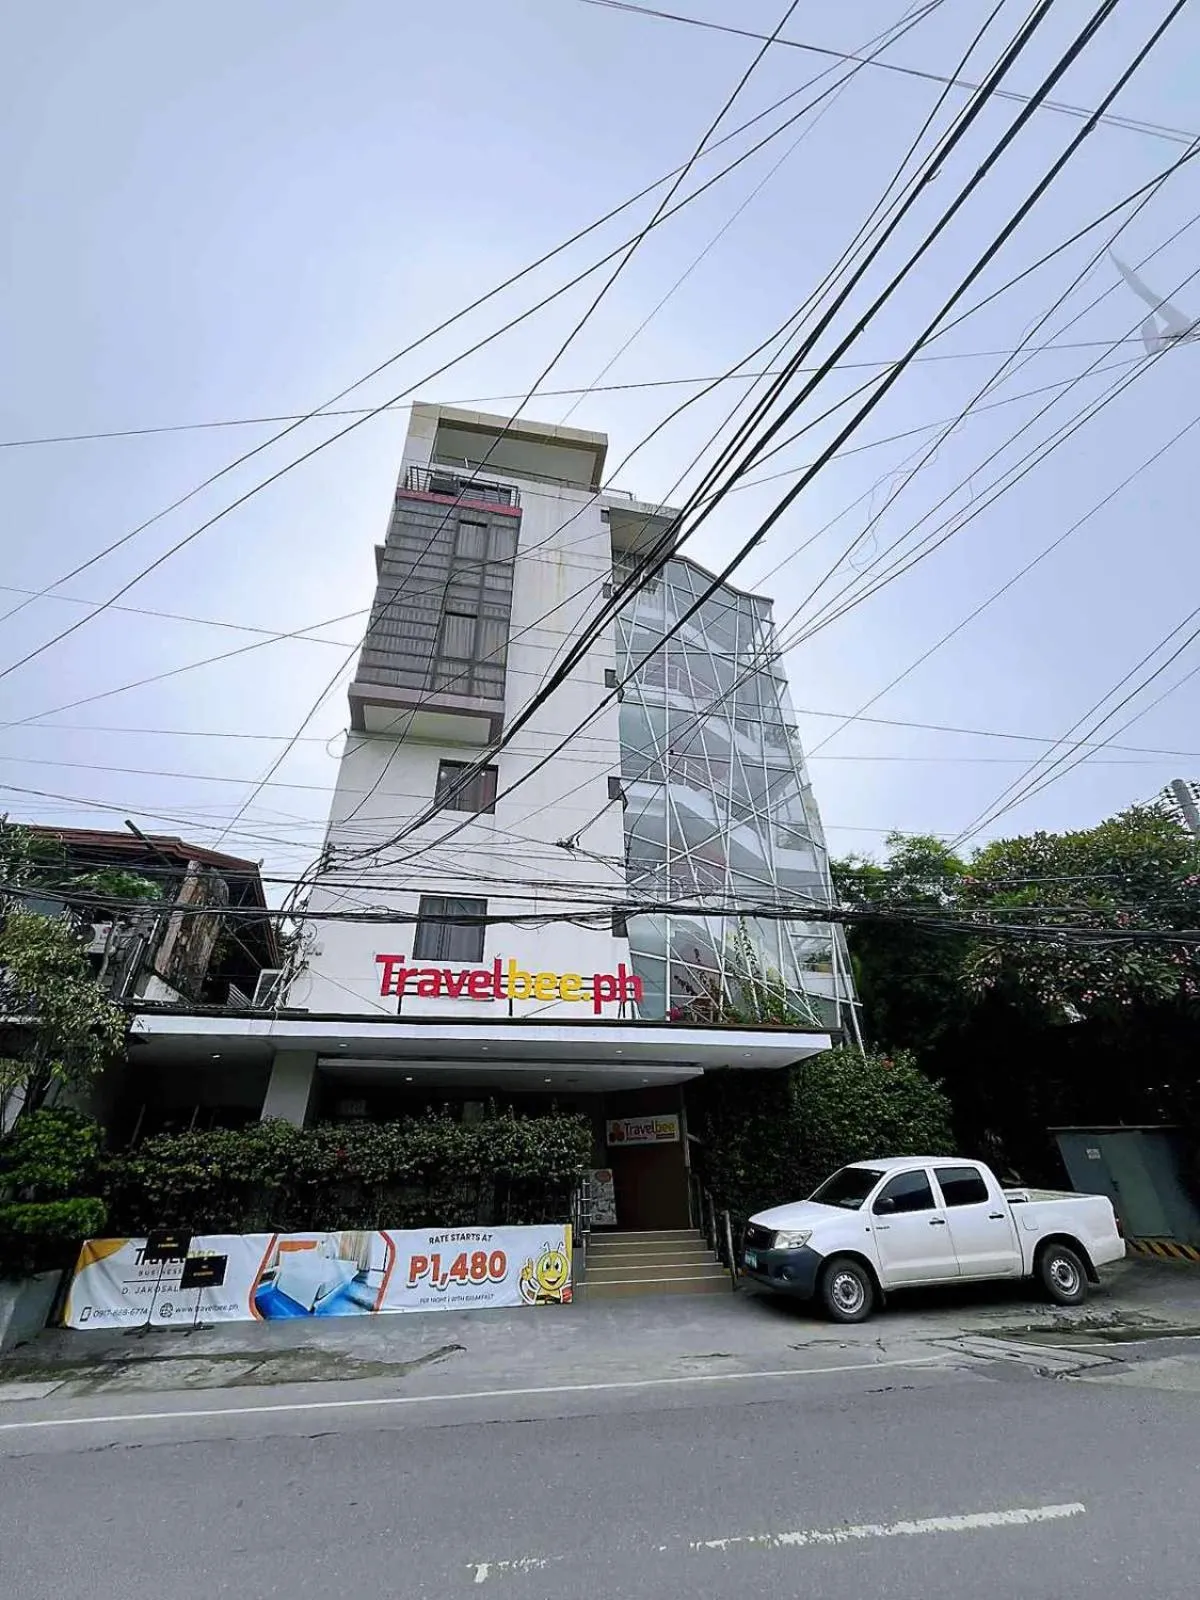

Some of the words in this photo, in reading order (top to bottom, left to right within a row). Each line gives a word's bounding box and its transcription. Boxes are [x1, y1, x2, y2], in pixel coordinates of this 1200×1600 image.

[375, 954, 644, 1014] Travelbee.ph
[429, 1235, 449, 1244] RATE
[451, 1233, 480, 1242] STARTS
[482, 1233, 493, 1242] AT
